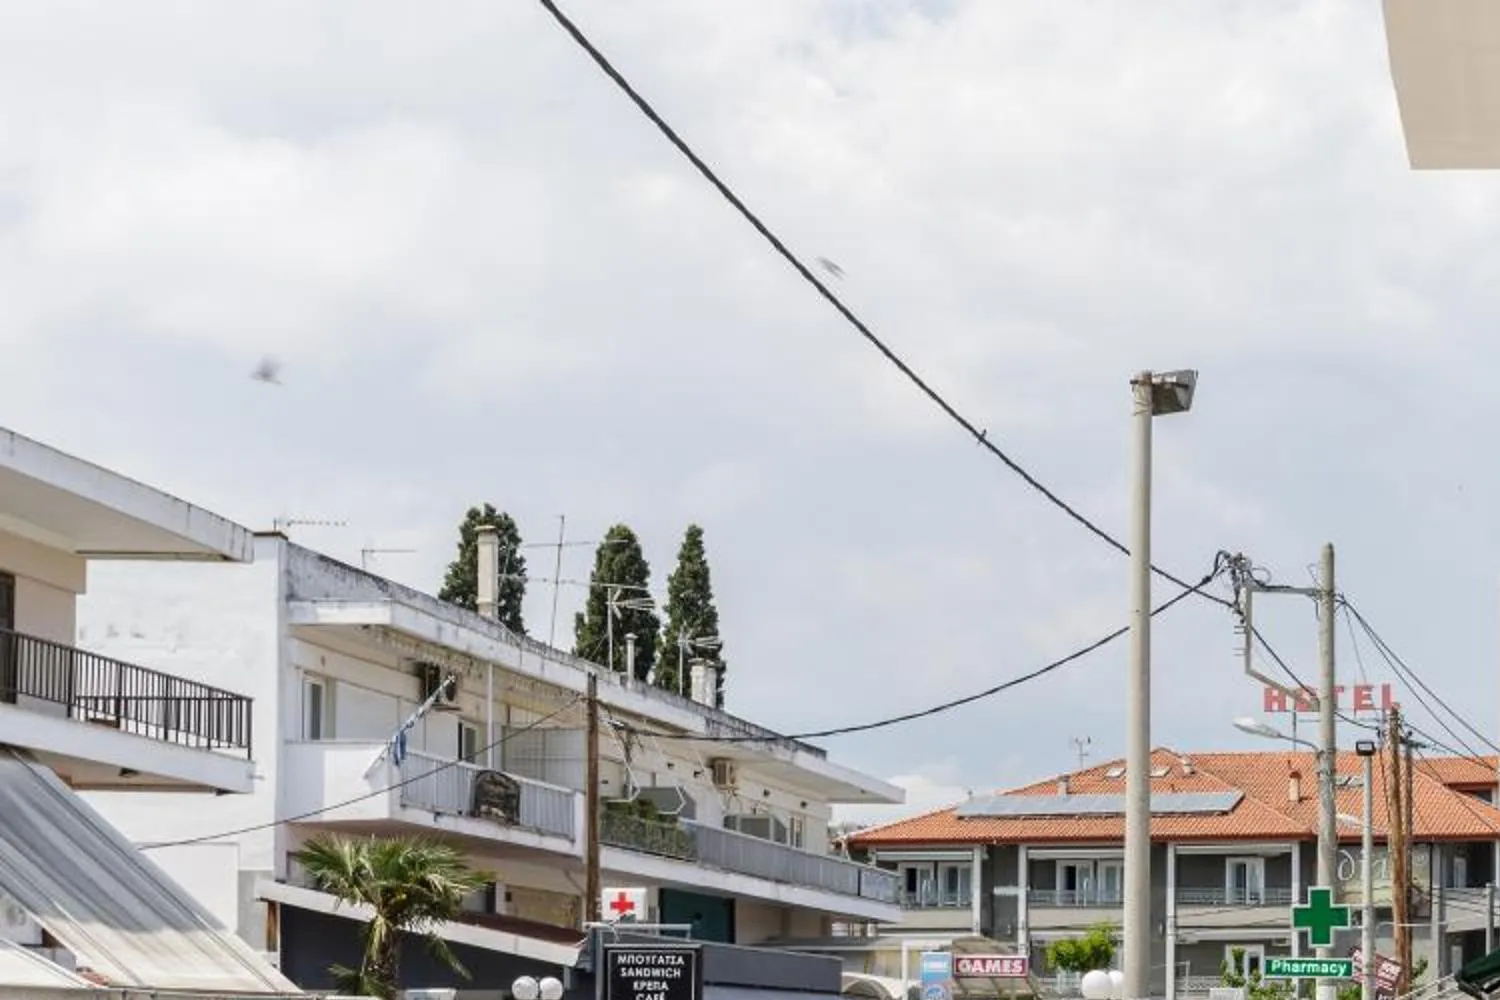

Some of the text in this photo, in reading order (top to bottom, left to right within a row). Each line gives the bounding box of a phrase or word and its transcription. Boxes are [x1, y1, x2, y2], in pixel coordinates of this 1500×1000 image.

[617, 954, 685, 965] ΜΠΟΥΓΑΤΣΑ
[620, 967, 681, 978] SANDWICH
[957, 959, 1023, 974] GAMES
[1271, 960, 1348, 977] Pharmacy
